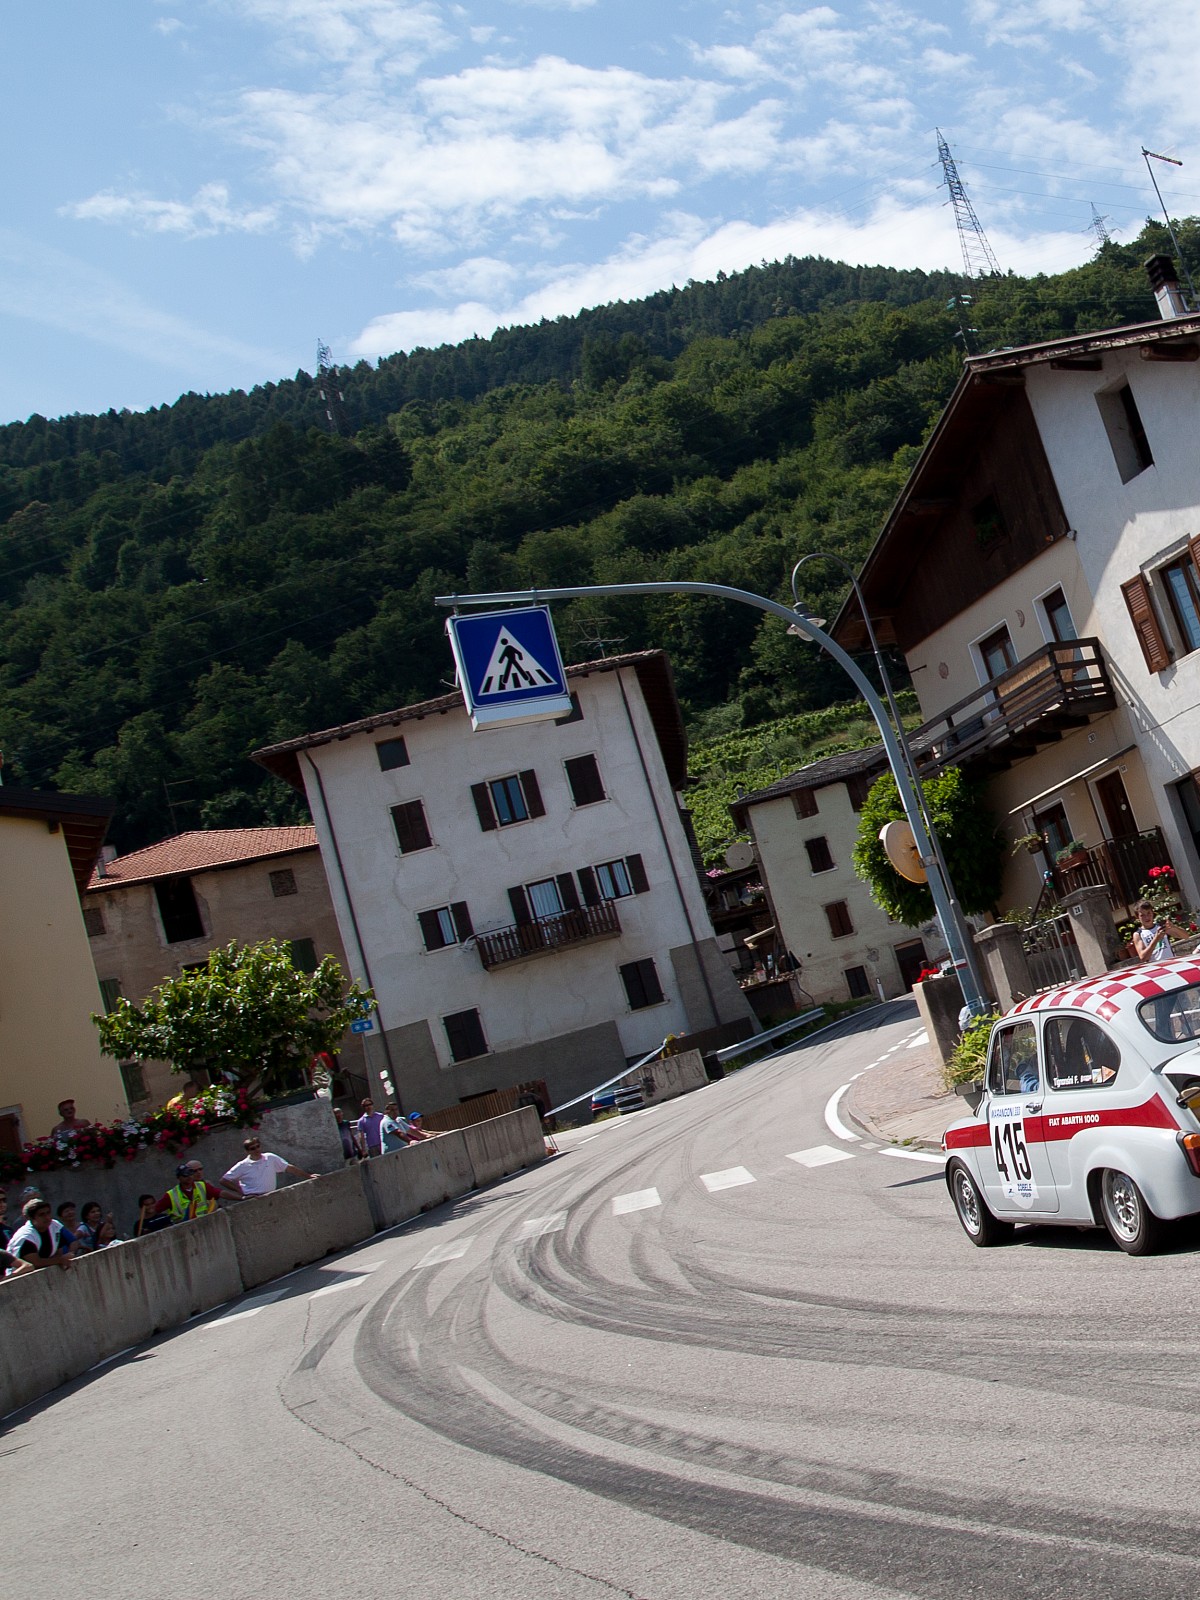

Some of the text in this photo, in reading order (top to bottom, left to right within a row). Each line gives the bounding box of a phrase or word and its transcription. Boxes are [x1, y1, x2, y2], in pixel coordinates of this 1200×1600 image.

[1048, 1113, 1100, 1127] FIAT ABARTH 1000
[994, 1122, 1032, 1182] 415
